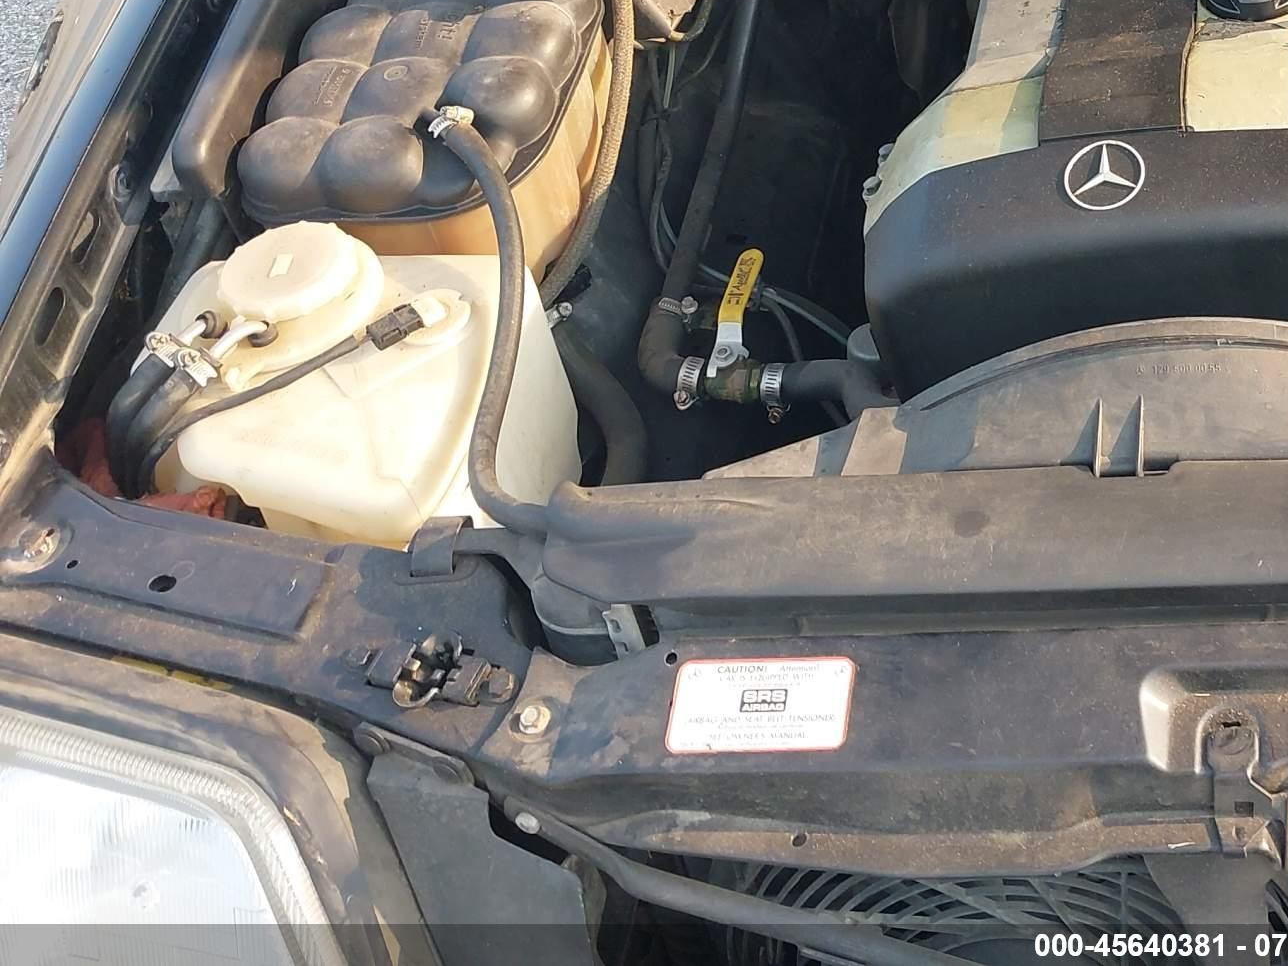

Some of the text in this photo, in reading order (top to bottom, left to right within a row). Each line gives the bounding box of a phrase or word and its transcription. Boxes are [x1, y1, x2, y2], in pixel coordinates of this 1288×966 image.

[717, 665, 768, 674] CAUTION!
[742, 690, 787, 703] SRS
[741, 703, 786, 712] AIRBAG
[722, 715, 741, 723] AND
